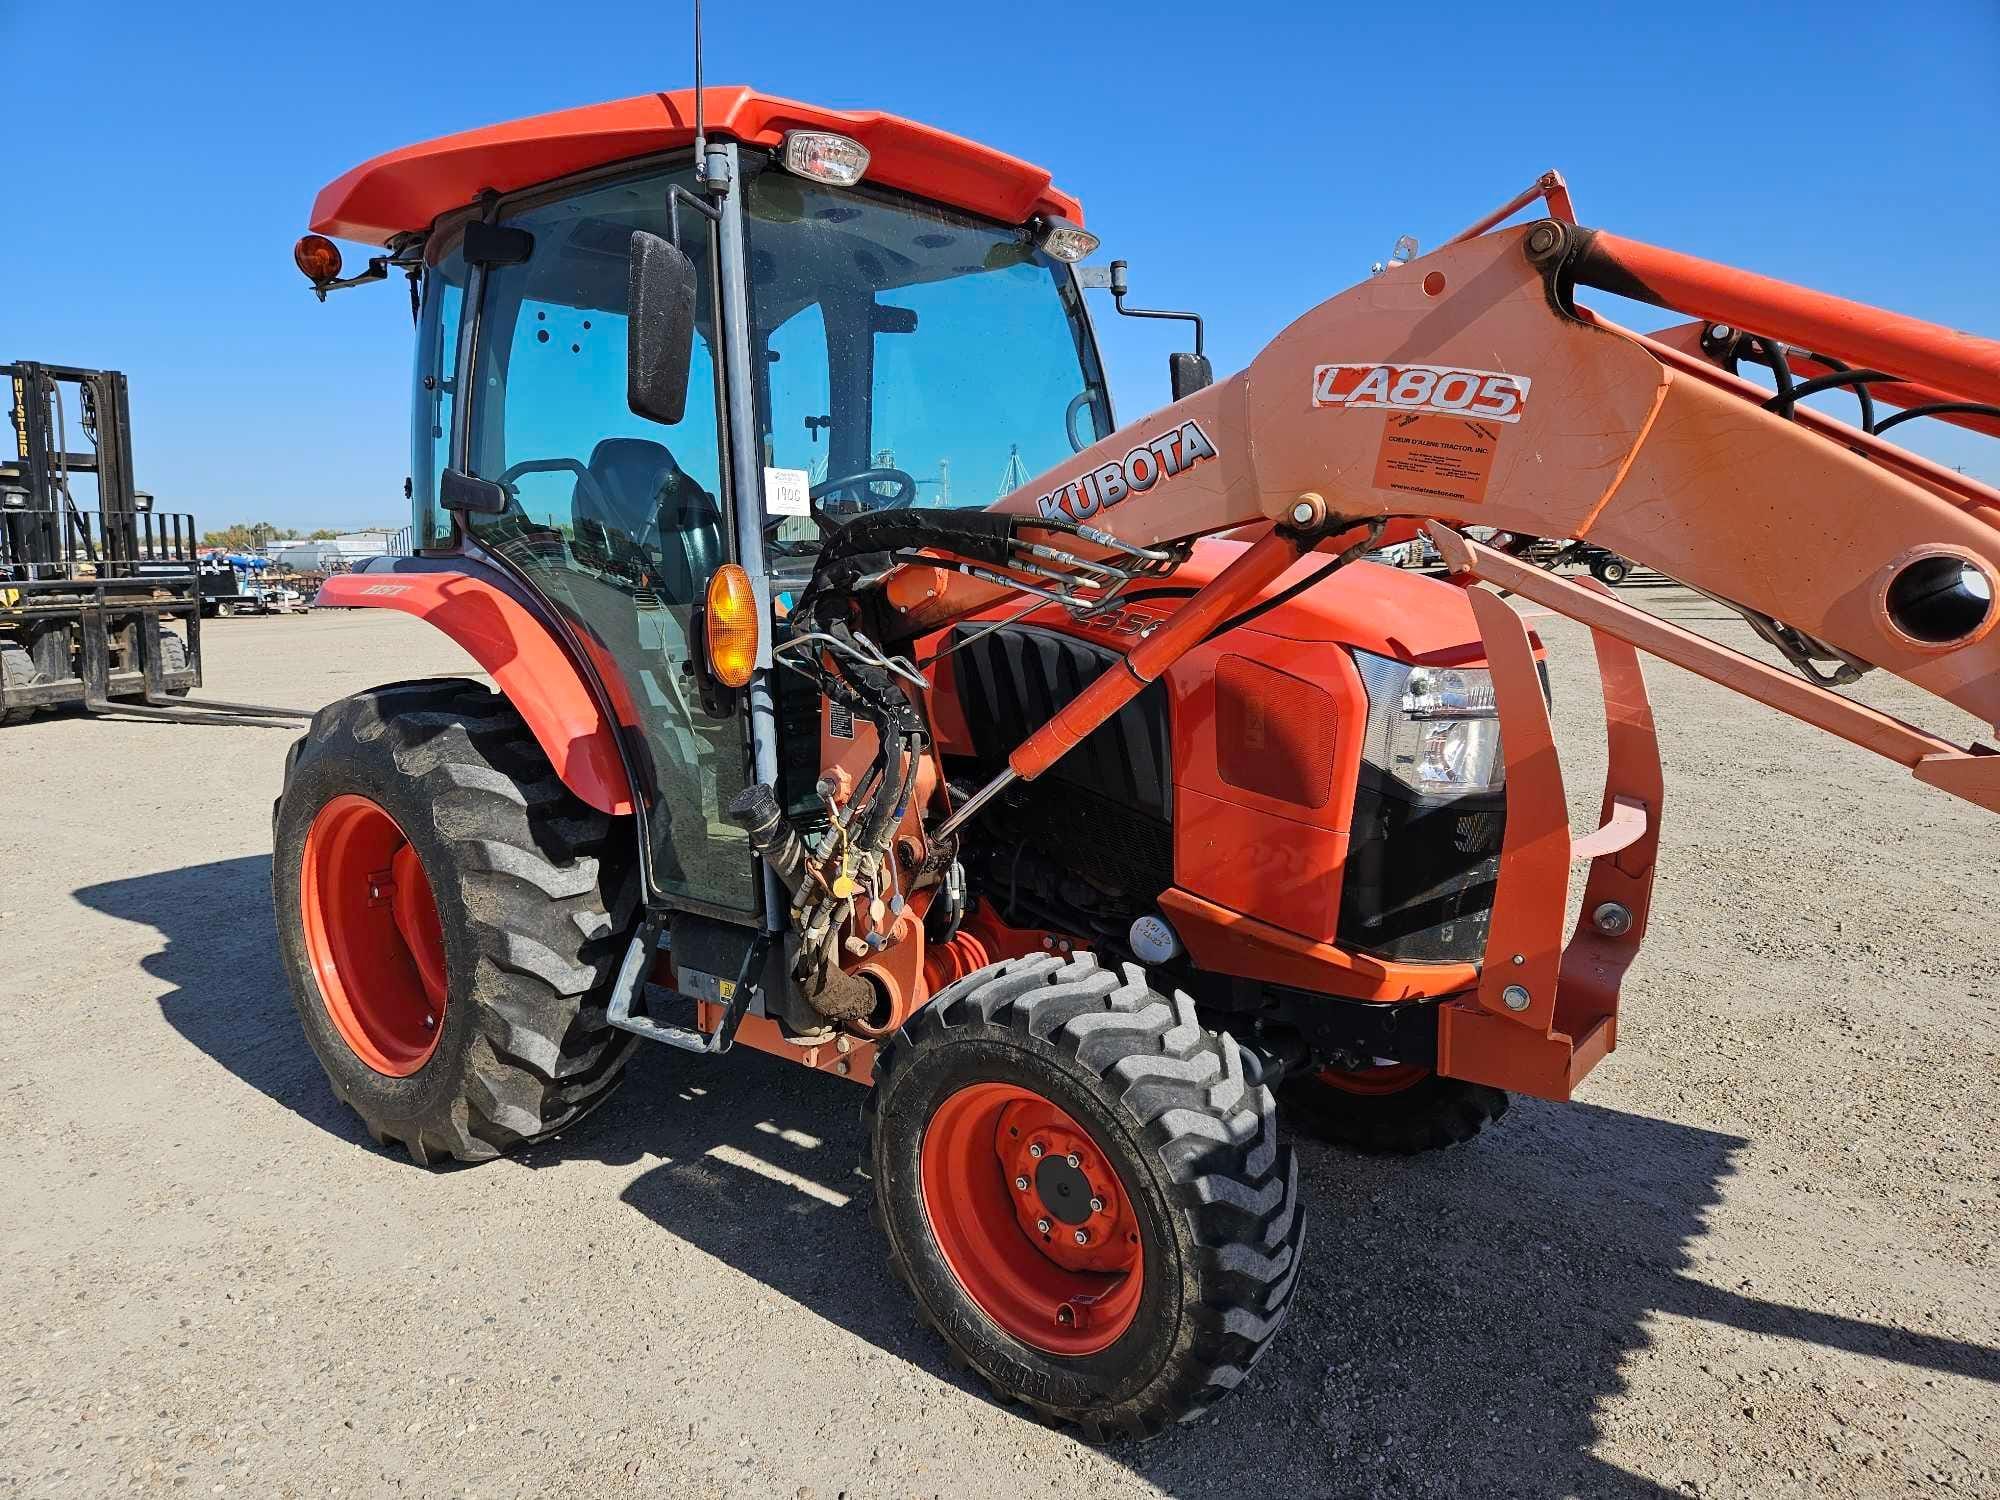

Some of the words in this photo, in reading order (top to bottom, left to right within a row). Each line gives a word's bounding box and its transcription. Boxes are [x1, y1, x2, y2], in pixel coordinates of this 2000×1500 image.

[14, 378, 28, 457] HYSTER
[1315, 365, 1521, 417] LA805
[1038, 420, 1218, 524] KUBOTA
